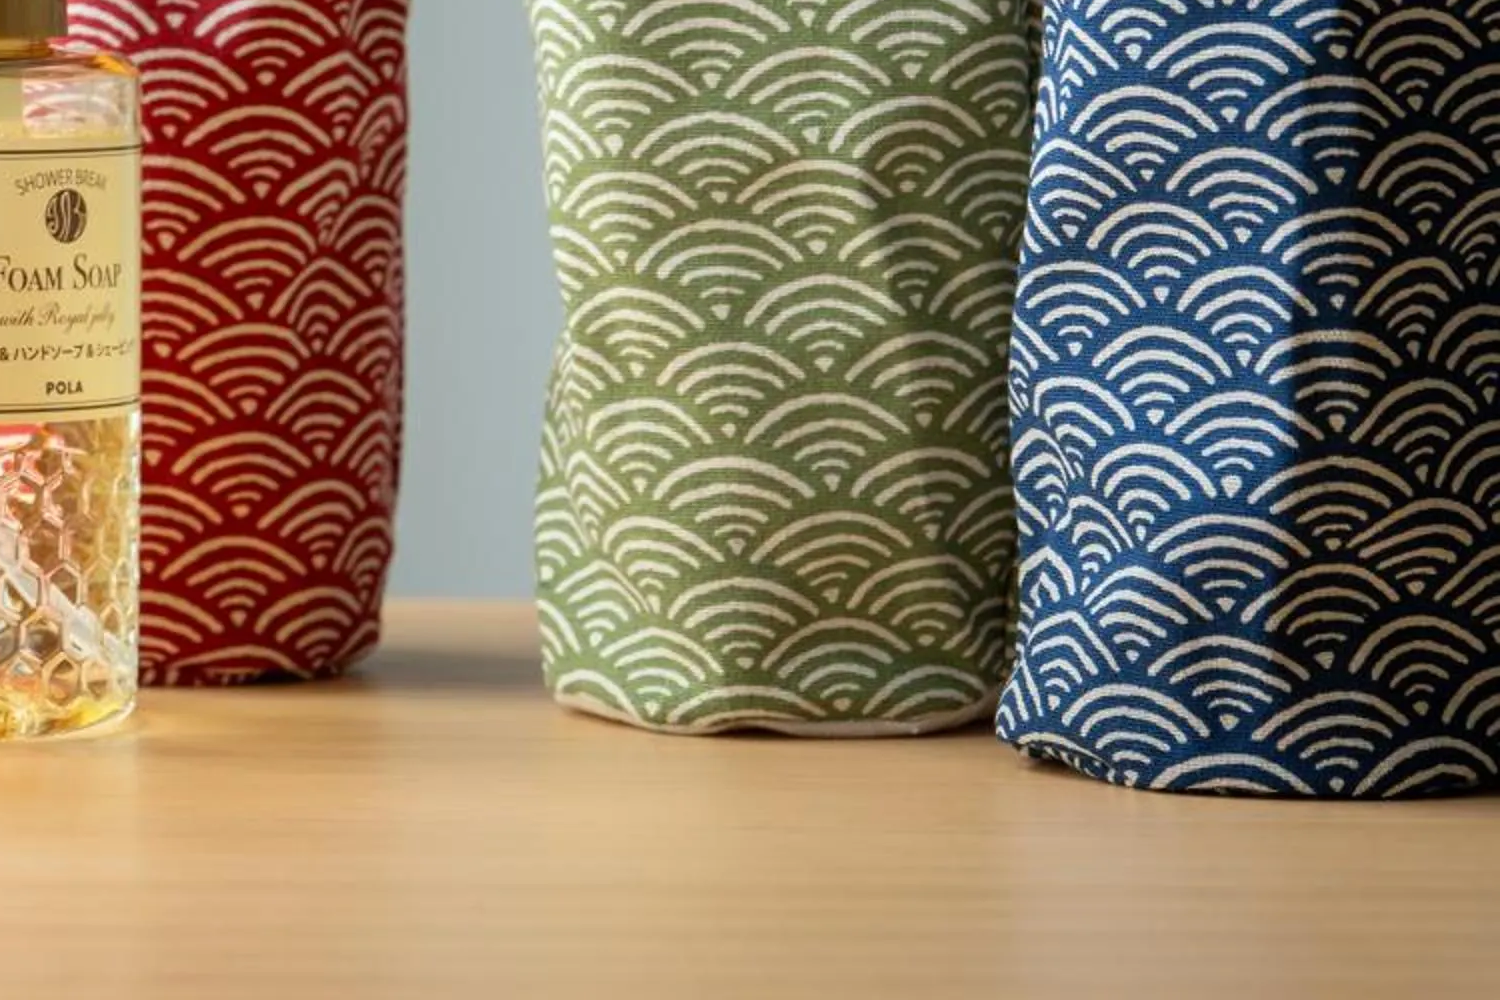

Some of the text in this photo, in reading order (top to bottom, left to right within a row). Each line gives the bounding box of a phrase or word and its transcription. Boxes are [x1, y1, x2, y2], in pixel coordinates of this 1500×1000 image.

[14, 168, 73, 196] SHOWER
[73, 253, 122, 289] SOAP
[45, 380, 84, 396] POLA
